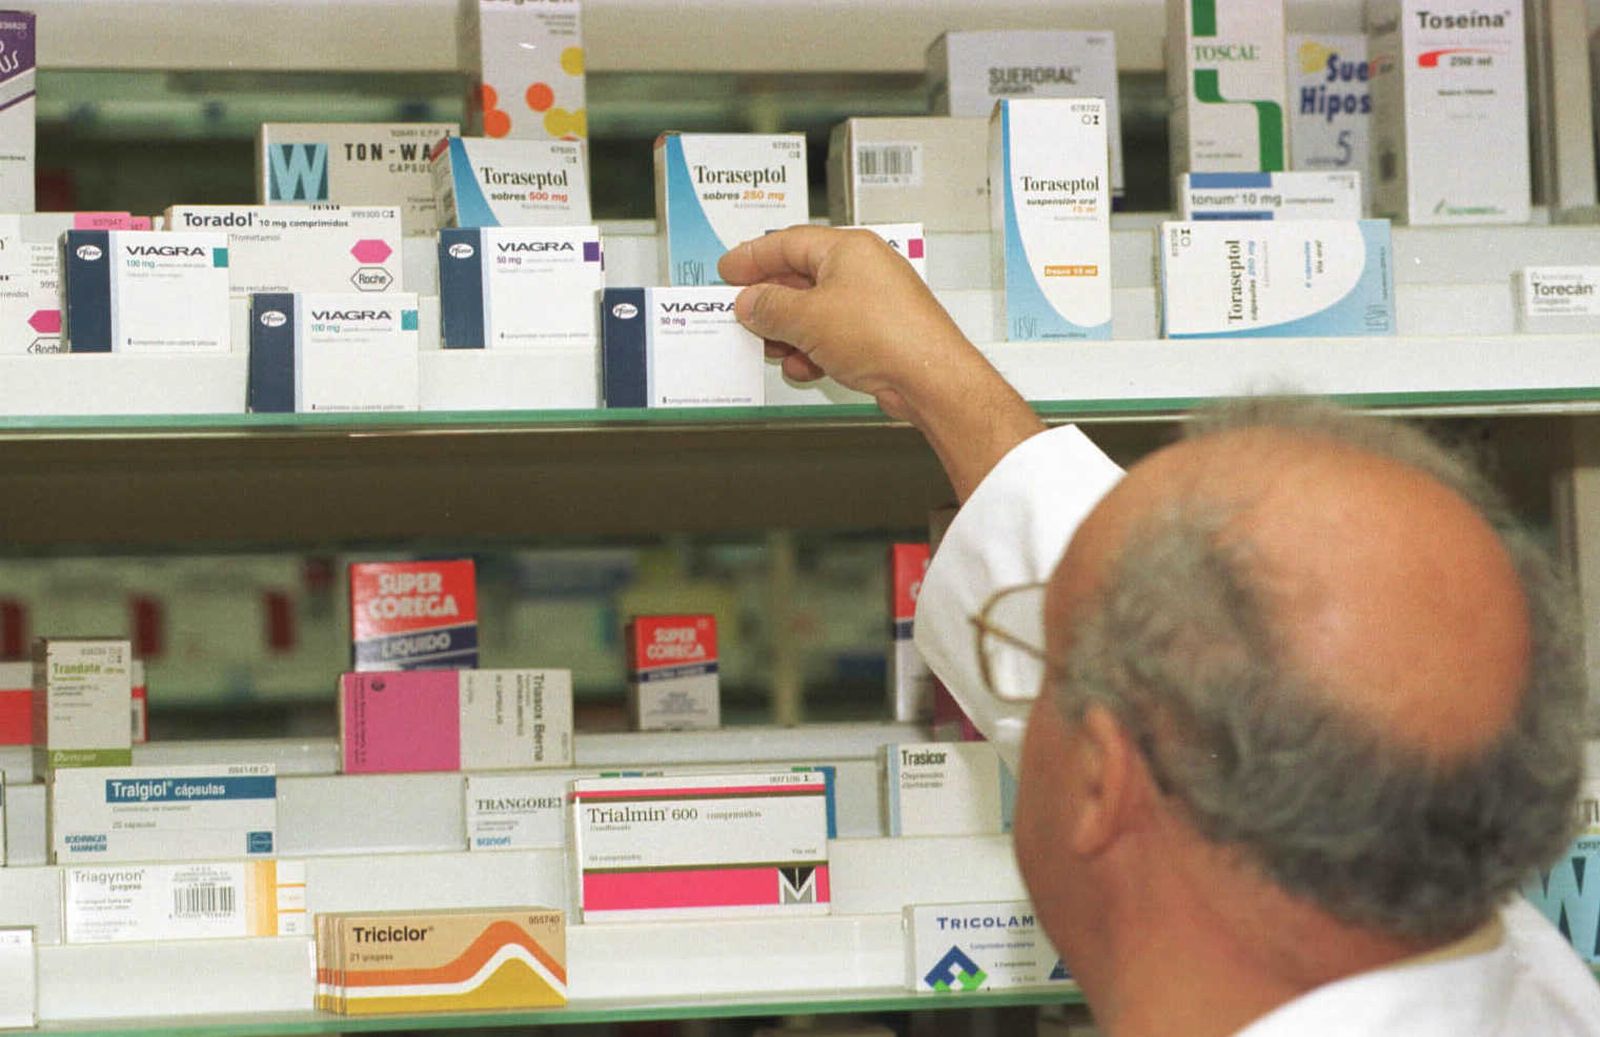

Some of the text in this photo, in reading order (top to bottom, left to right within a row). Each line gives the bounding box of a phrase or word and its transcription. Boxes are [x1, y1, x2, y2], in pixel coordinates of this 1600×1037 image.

[1416, 9, 1504, 29] Toseína
[1195, 44, 1259, 61] TOSCAL
[1300, 85, 1371, 123] Hipos
[480, 167, 568, 190] Toraseptol
[693, 165, 787, 188] Toraseptol
[1020, 176, 1100, 195] Toraseptol
[491, 192, 568, 203] sobres 500 mg
[703, 191, 785, 202] sobres 250 mg
[1191, 193, 1234, 206] tonum
[1242, 193, 1257, 206] 10
[1260, 193, 1283, 207] mg
[183, 212, 349, 230] Toradol 10 mg comprimidos
[126, 246, 207, 257] VIAGRA
[497, 242, 575, 252] VIAGRA
[142, 260, 156, 270] mg
[496, 256, 508, 264] 50
[508, 257, 522, 266] mg
[358, 273, 387, 285] Roche
[1225, 240, 1246, 325] Toraseptol
[312, 310, 392, 321] VIAGRA
[672, 318, 686, 327] mg
[326, 324, 341, 333] mg
[378, 573, 442, 595] SUPER
[369, 595, 459, 620] COREGA
[654, 628, 697, 644] SUPER
[647, 643, 706, 661] COREGA
[533, 723, 546, 763] Berna
[902, 750, 947, 766] Trasicor
[112, 780, 226, 800] Tralgiol cápsulas
[587, 805, 666, 826] Trialmin
[671, 808, 698, 821] 600
[73, 870, 142, 887] Triagynon
[937, 915, 1035, 930] TRICOLAM
[352, 926, 428, 944] Triciclor
